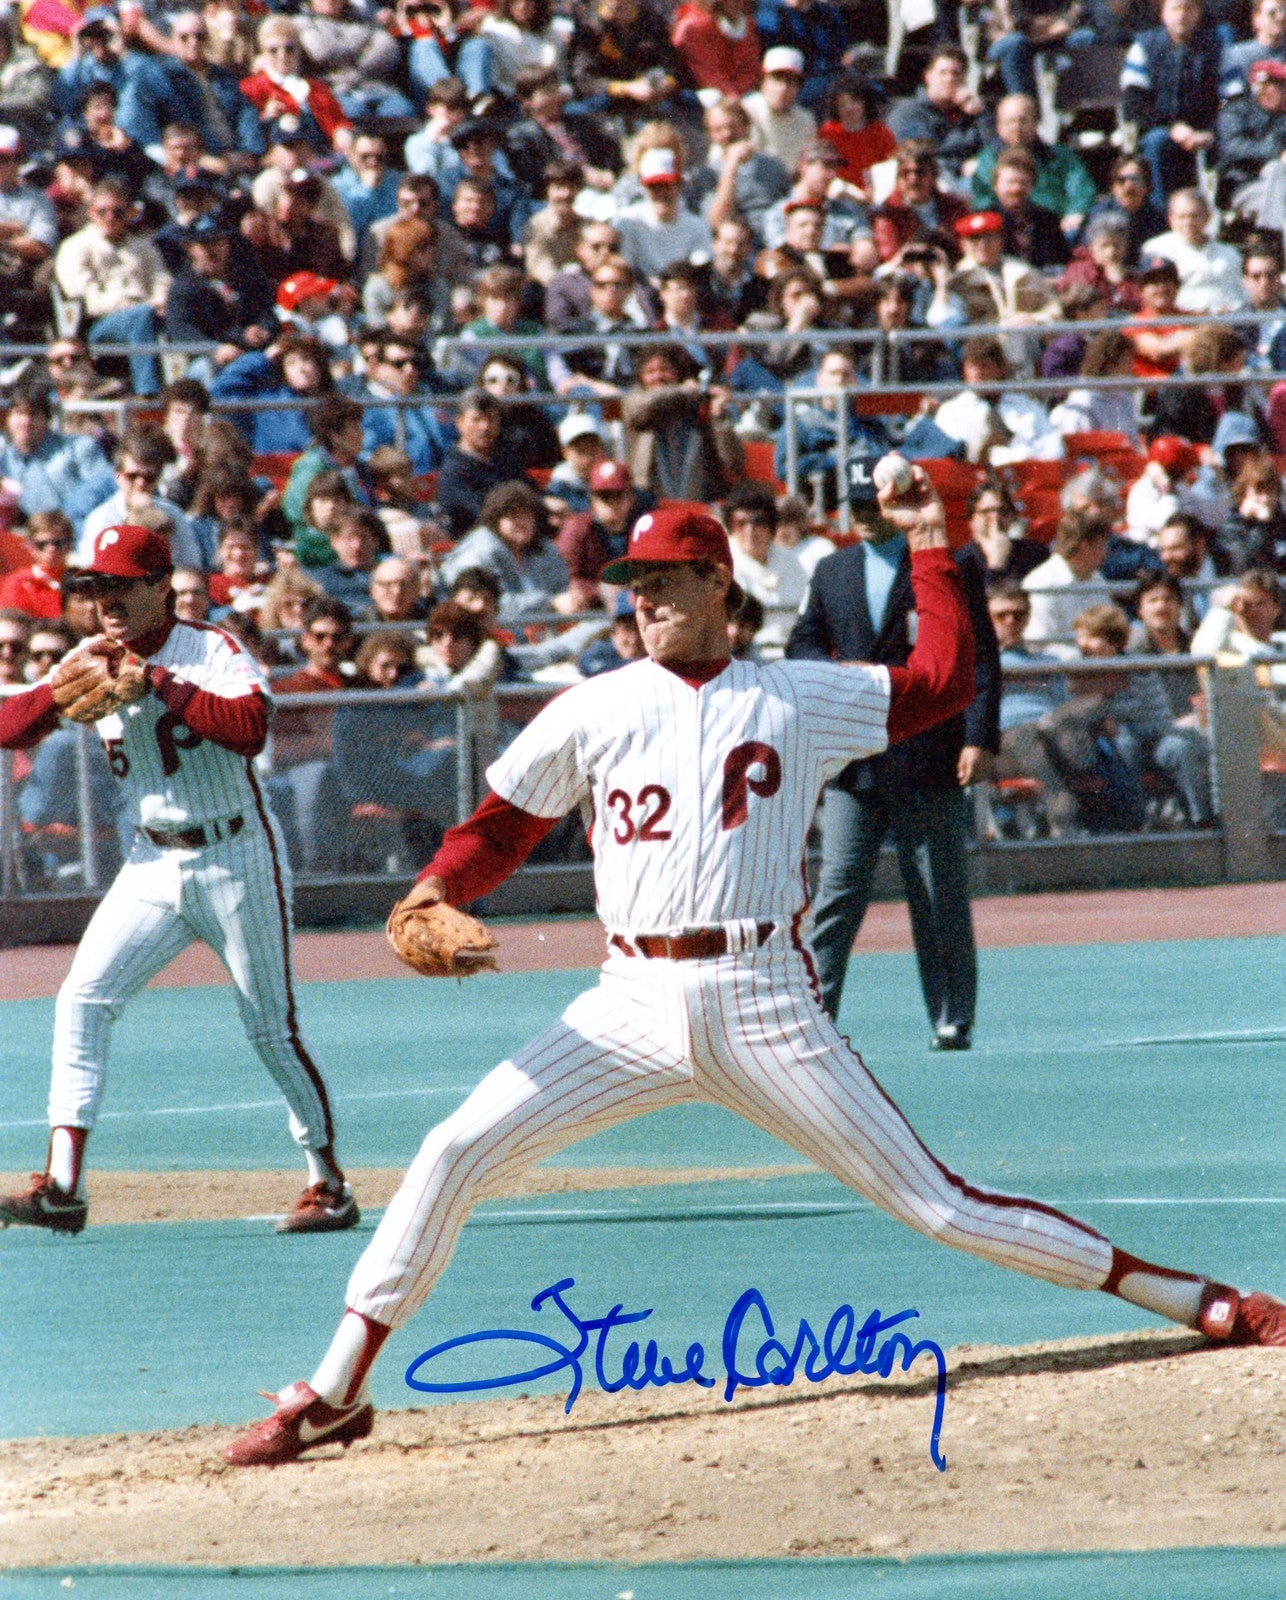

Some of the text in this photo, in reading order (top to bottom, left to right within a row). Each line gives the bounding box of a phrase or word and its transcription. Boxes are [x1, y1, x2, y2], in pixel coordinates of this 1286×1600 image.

[99, 529, 119, 551] P
[632, 514, 654, 542] P
[721, 741, 782, 832] P
[607, 784, 672, 845] 32
